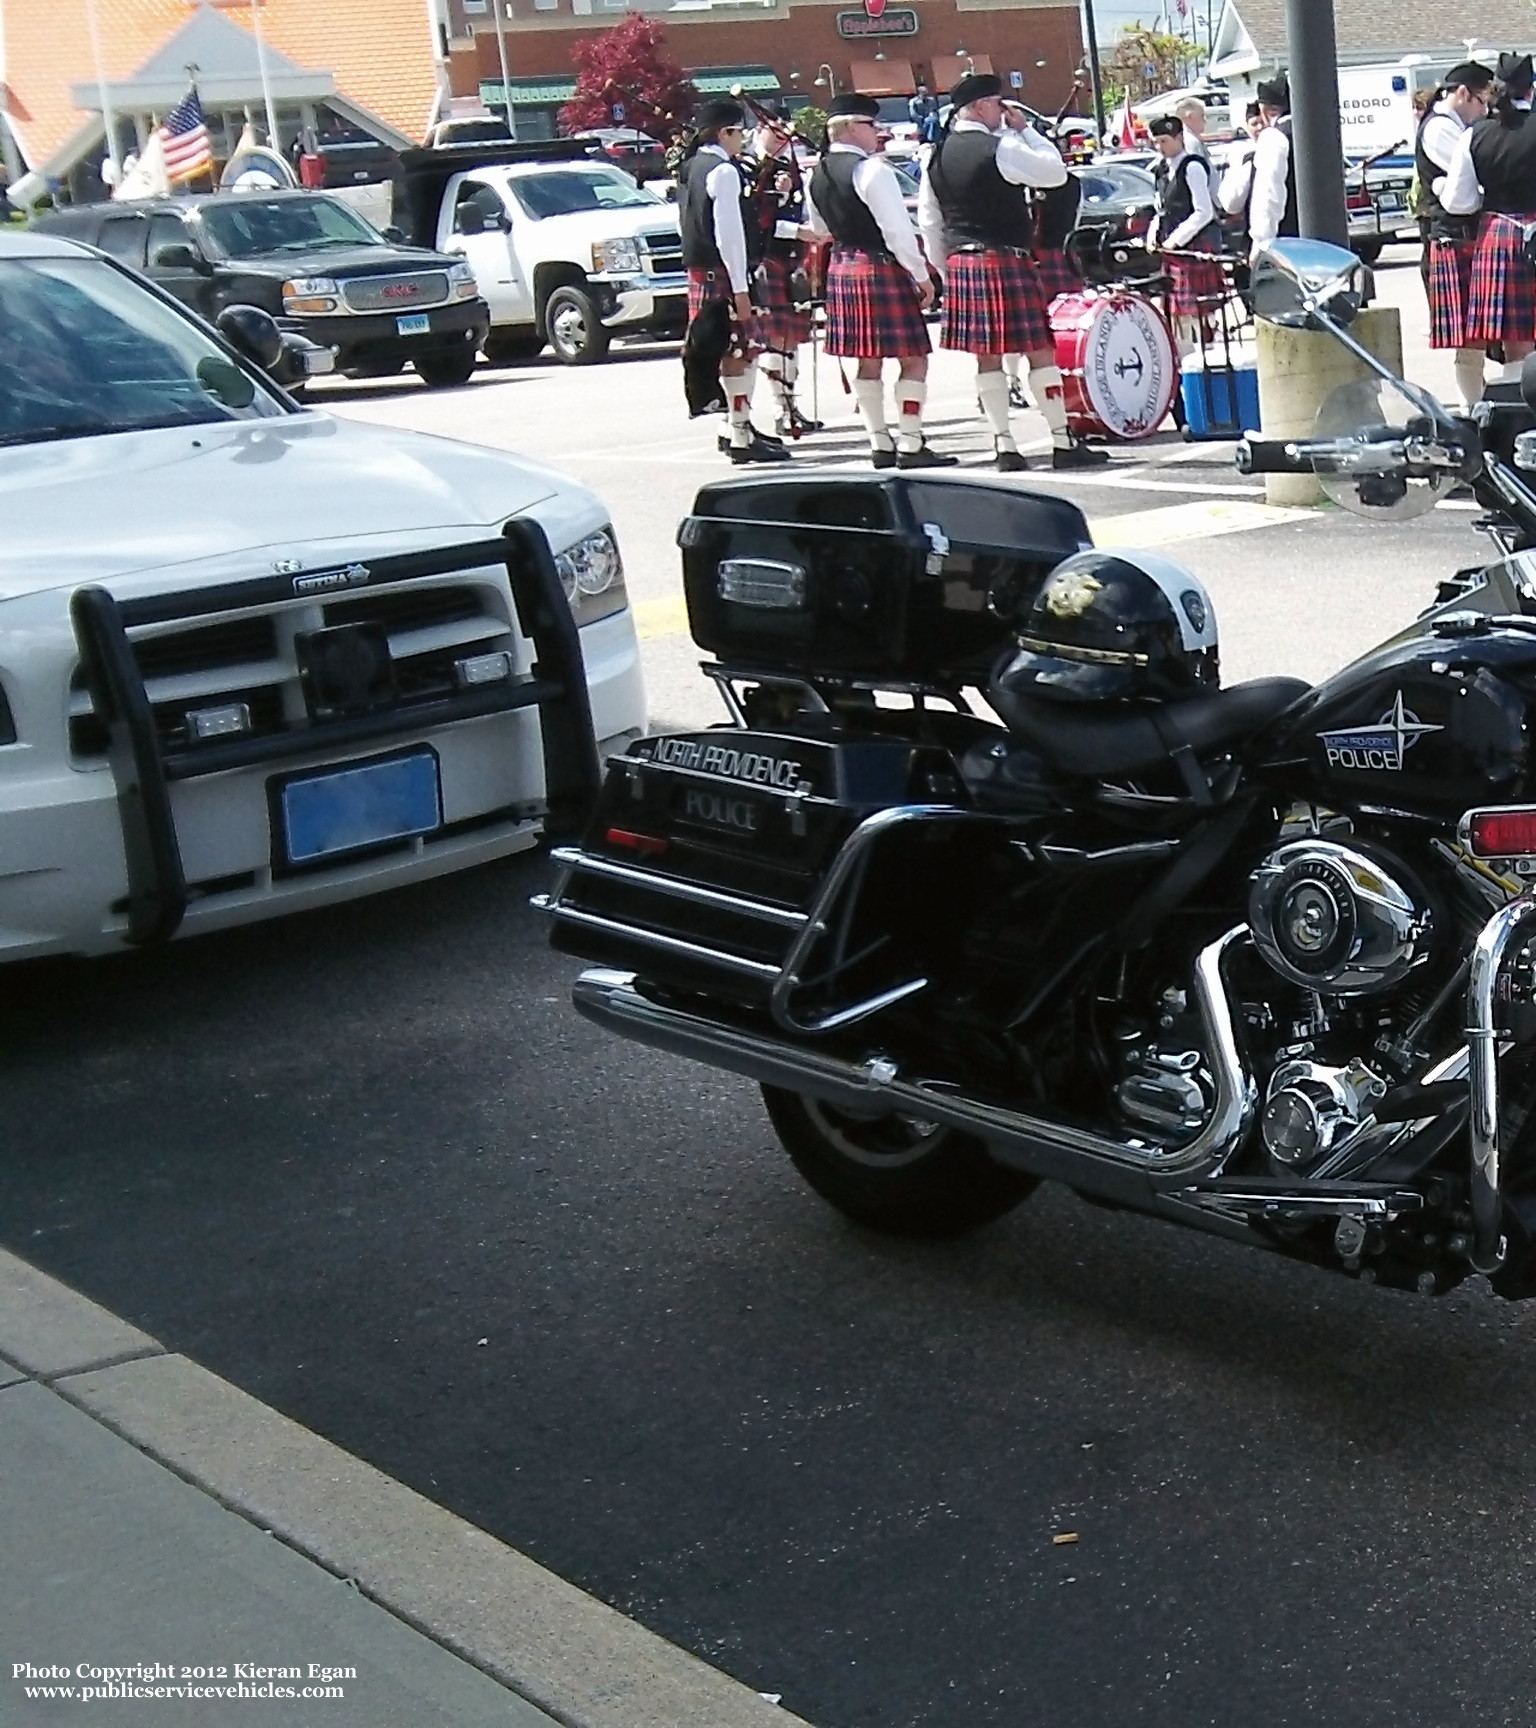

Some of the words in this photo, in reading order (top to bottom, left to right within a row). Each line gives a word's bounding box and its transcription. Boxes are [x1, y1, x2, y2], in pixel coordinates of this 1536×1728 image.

[1343, 98, 1391, 109] EBORO
[1340, 114, 1375, 125] OLICE
[652, 737, 703, 769] NORTH
[702, 745, 801, 788] PROVIDENCE
[1327, 748, 1400, 770] POLICE
[685, 790, 756, 830] POLICE
